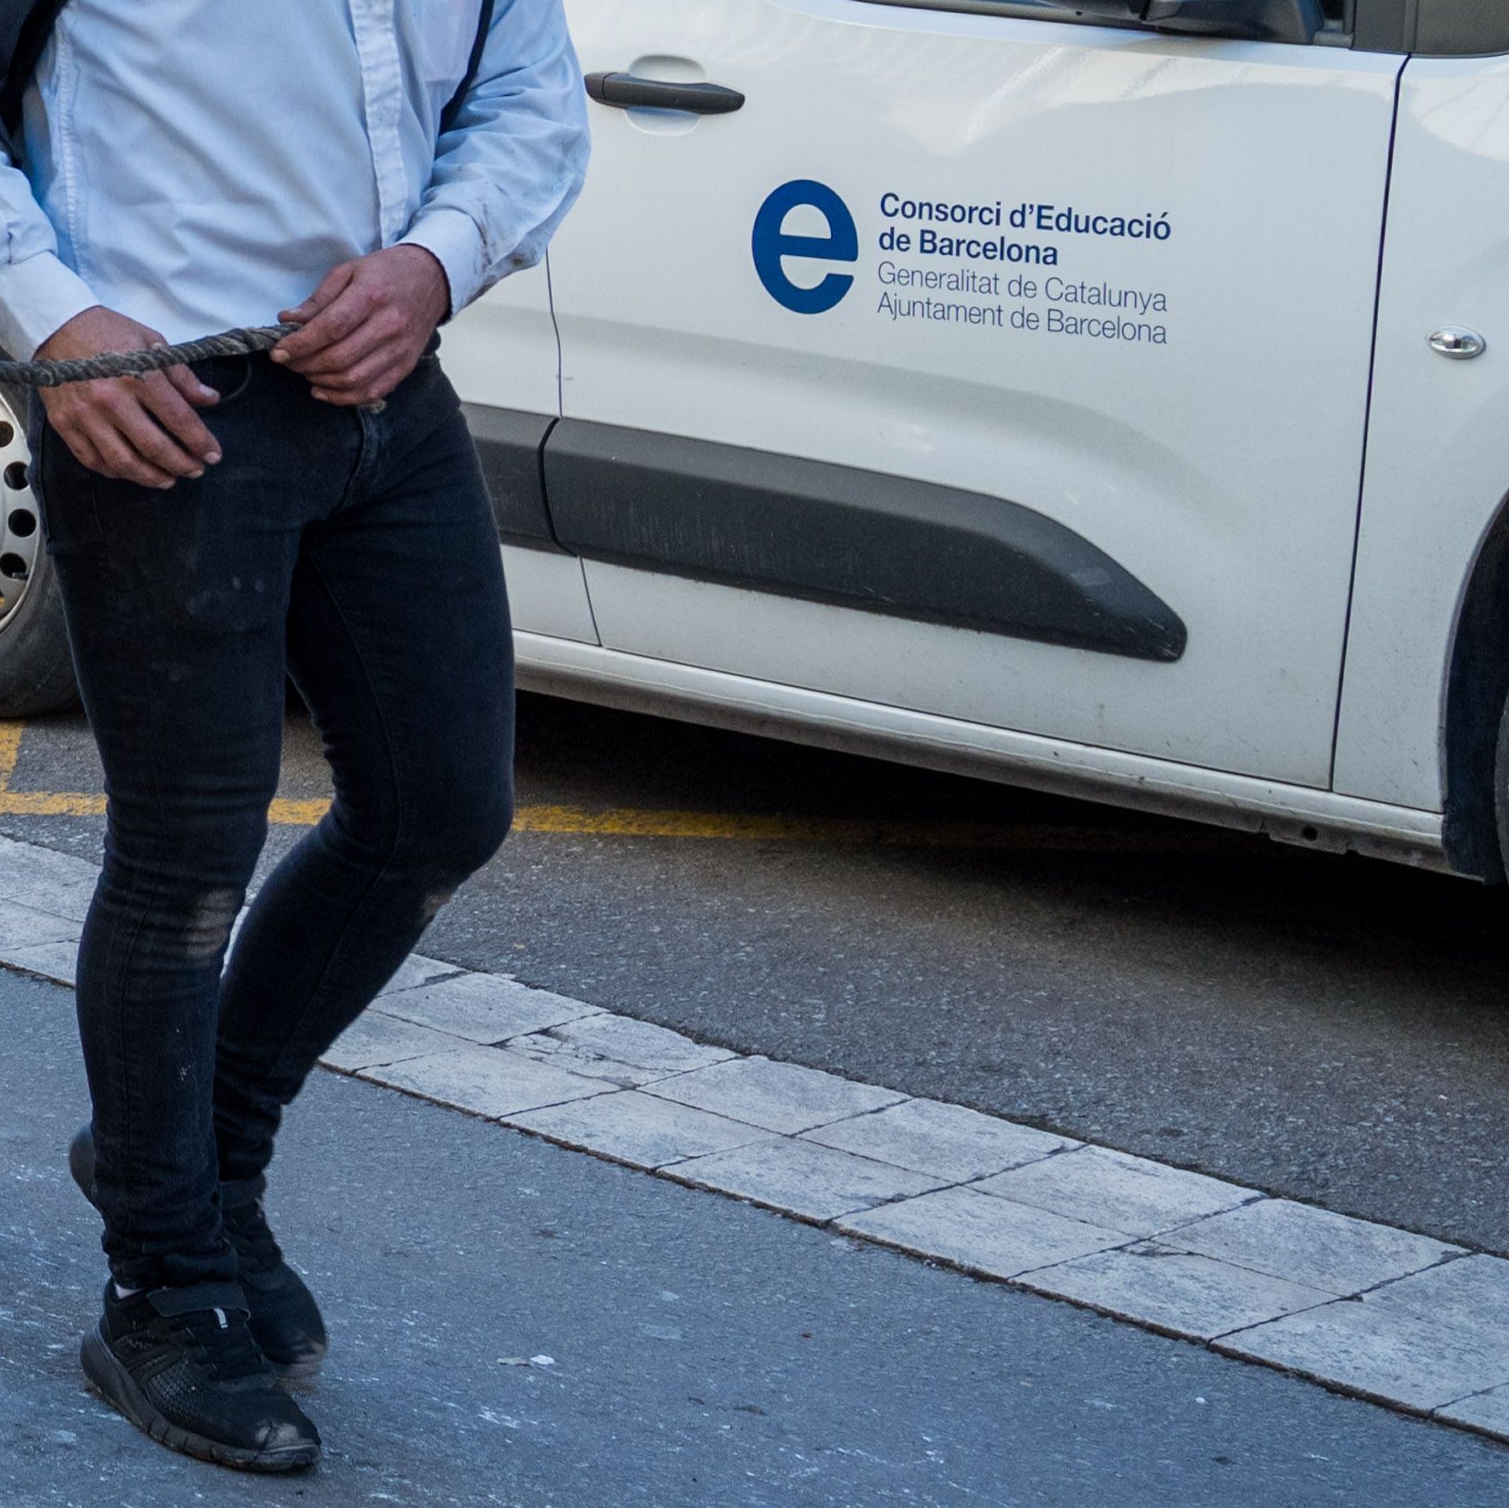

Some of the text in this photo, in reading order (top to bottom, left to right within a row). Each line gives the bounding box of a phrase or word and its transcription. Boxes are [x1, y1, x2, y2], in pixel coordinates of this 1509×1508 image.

[880, 192, 1172, 241] Consorci d'Educació
[751, 178, 859, 315] e
[878, 227, 1059, 266] de Barcelona
[877, 261, 1168, 316] Generalitat de Catalunya
[877, 291, 1168, 345] Ajuntament de Barcelona
